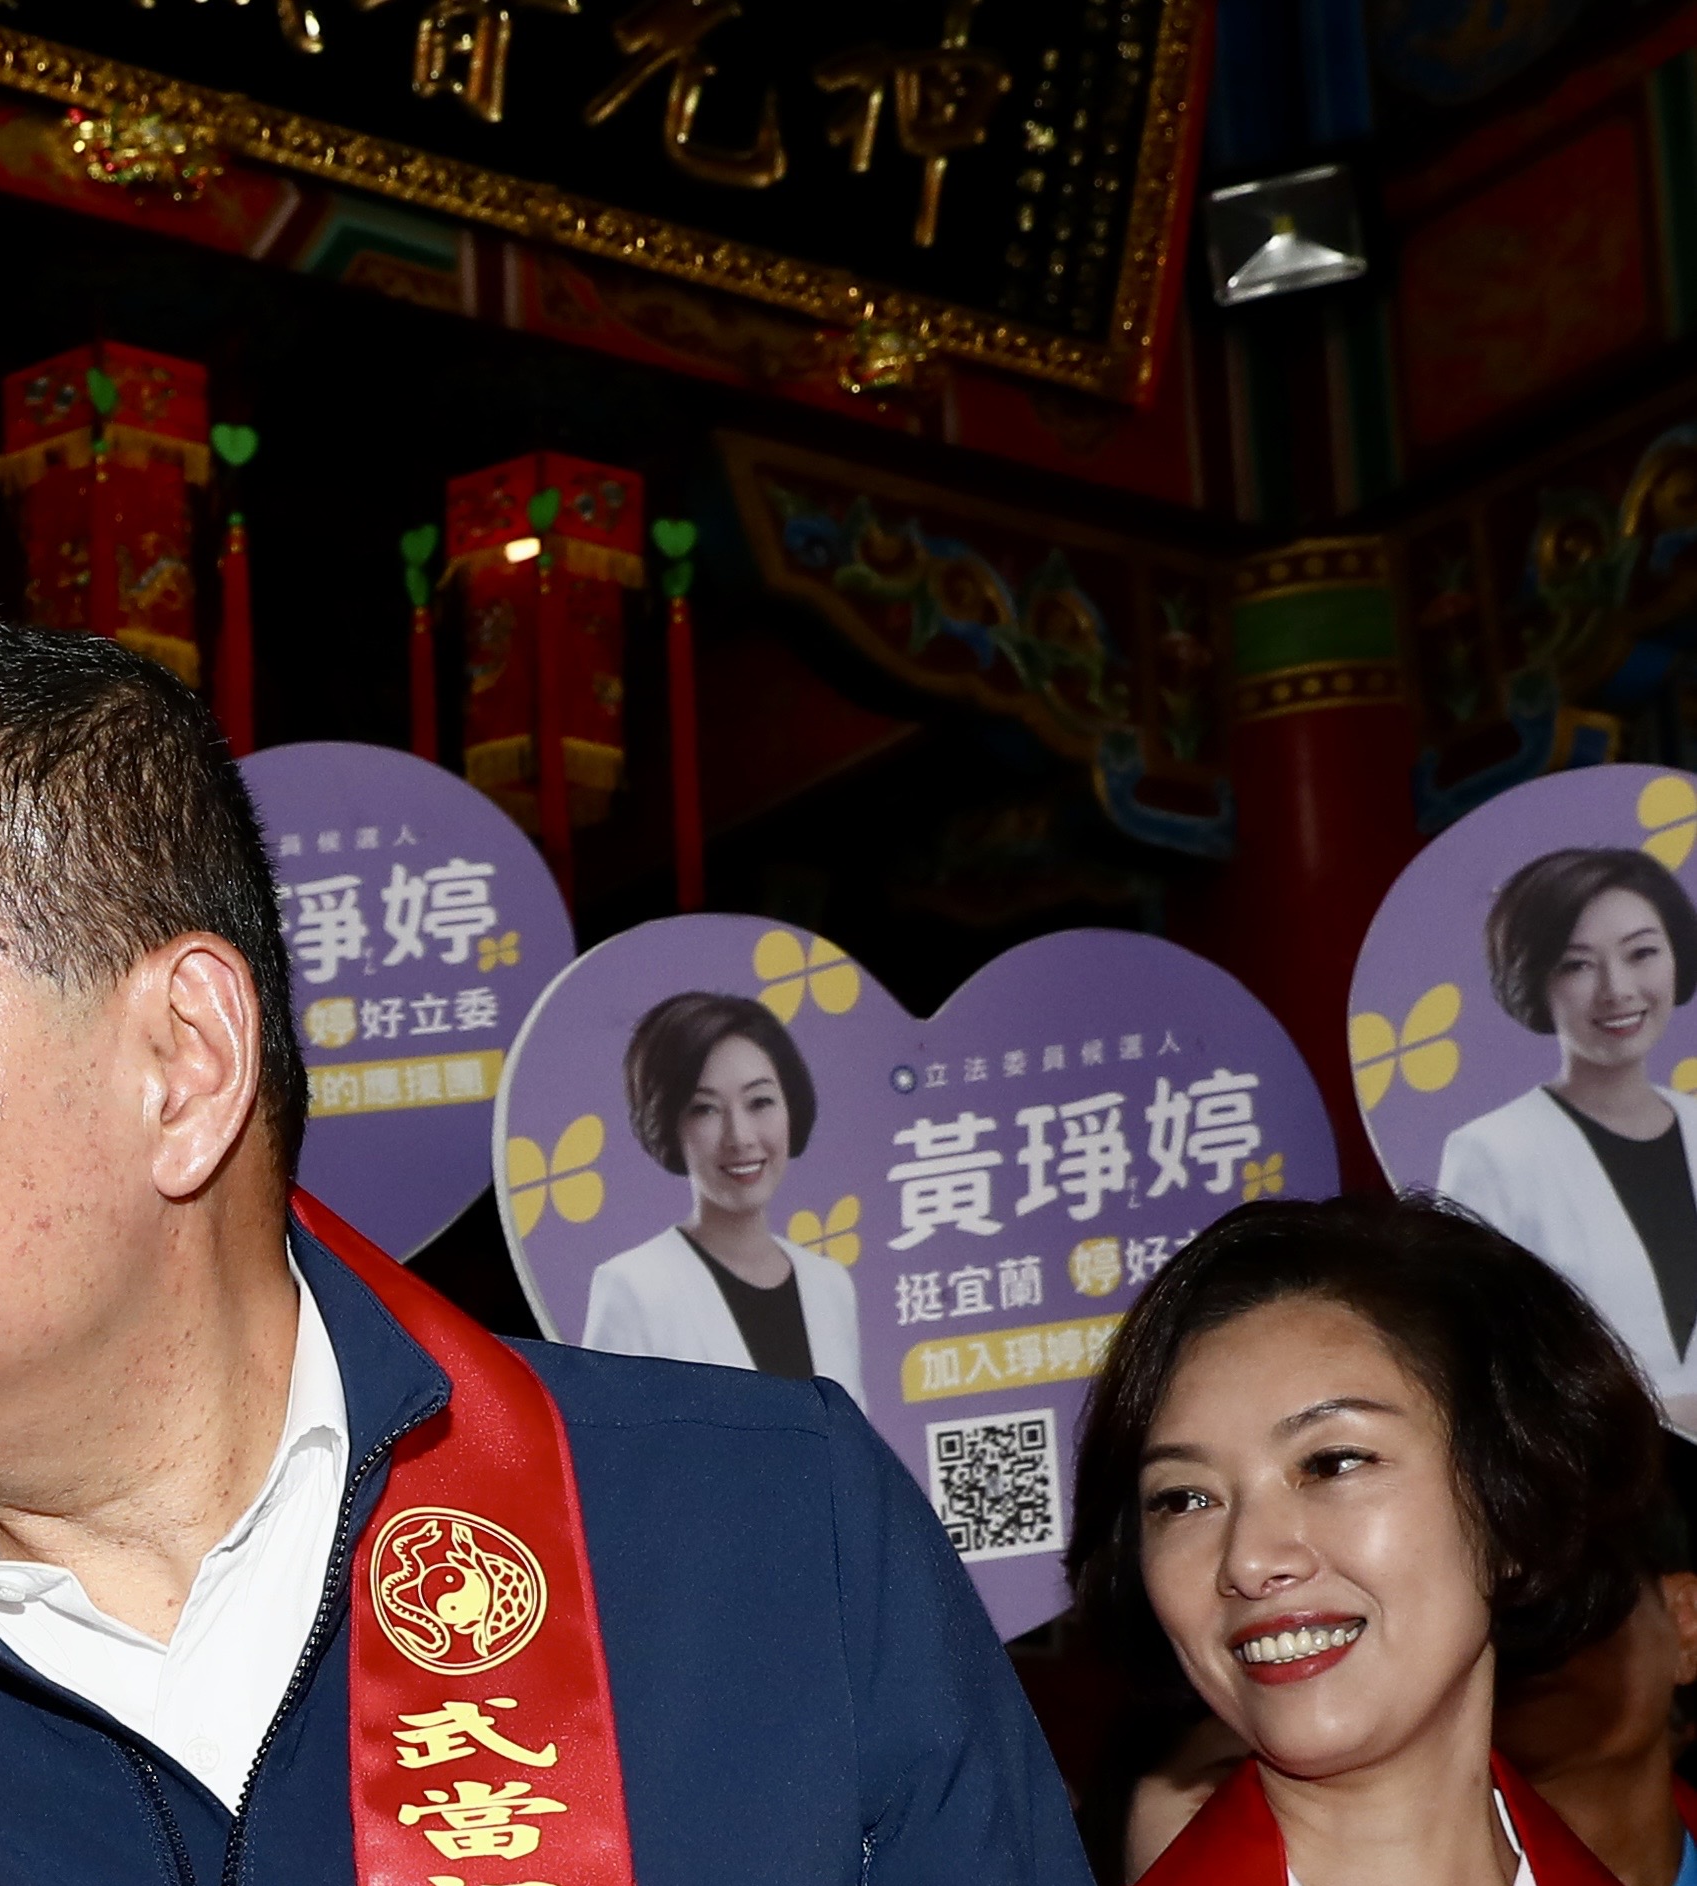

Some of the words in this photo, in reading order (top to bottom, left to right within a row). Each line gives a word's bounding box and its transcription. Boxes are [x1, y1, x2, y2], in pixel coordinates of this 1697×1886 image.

[309, 986, 500, 1046] 婷好立委
[922, 1029, 1182, 1090] 立法委員候選人
[886, 1067, 1262, 1252] 黃琤婷
[894, 1255, 1043, 1327] 挺宜蘭
[1071, 1228, 1202, 1295] 婷好
